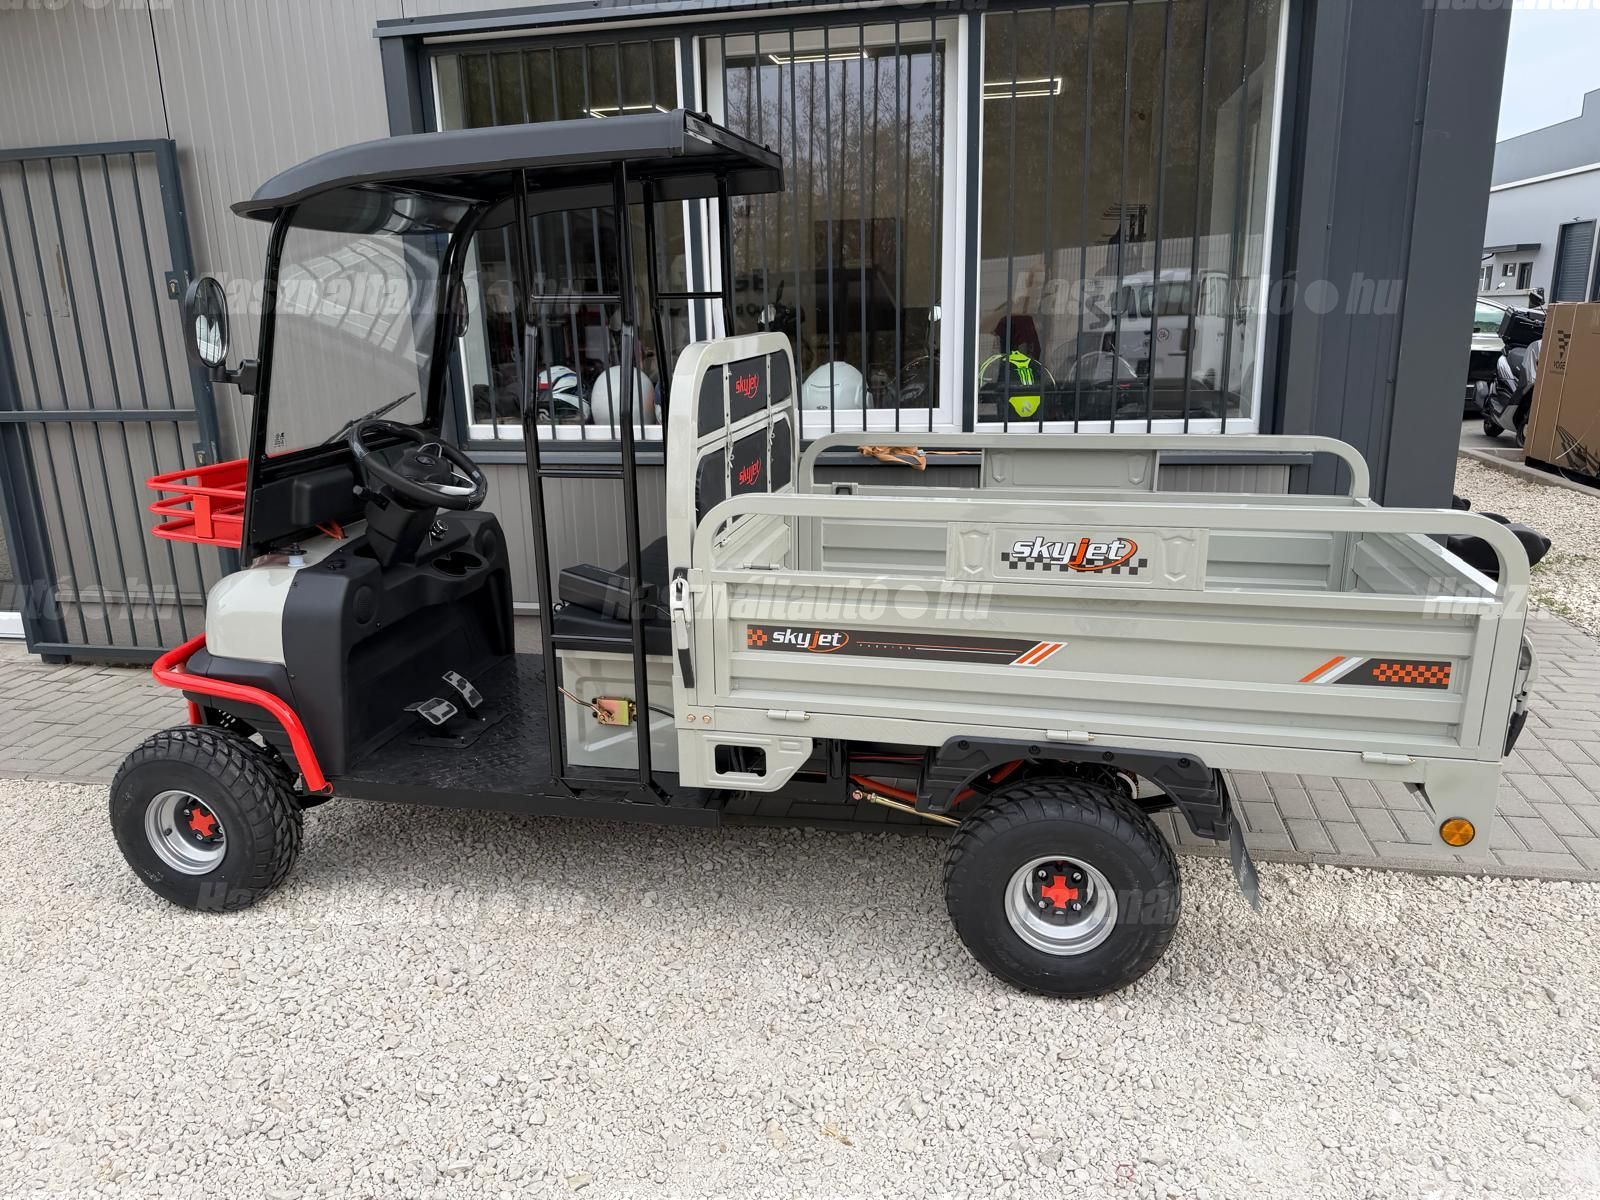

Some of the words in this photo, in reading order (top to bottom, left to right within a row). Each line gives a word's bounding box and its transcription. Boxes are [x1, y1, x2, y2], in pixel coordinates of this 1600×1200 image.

[736, 374, 759, 398] skyjet
[739, 458, 761, 485] skyjet
[1012, 536, 1130, 567] skyjet
[772, 629, 845, 651] skyjet
